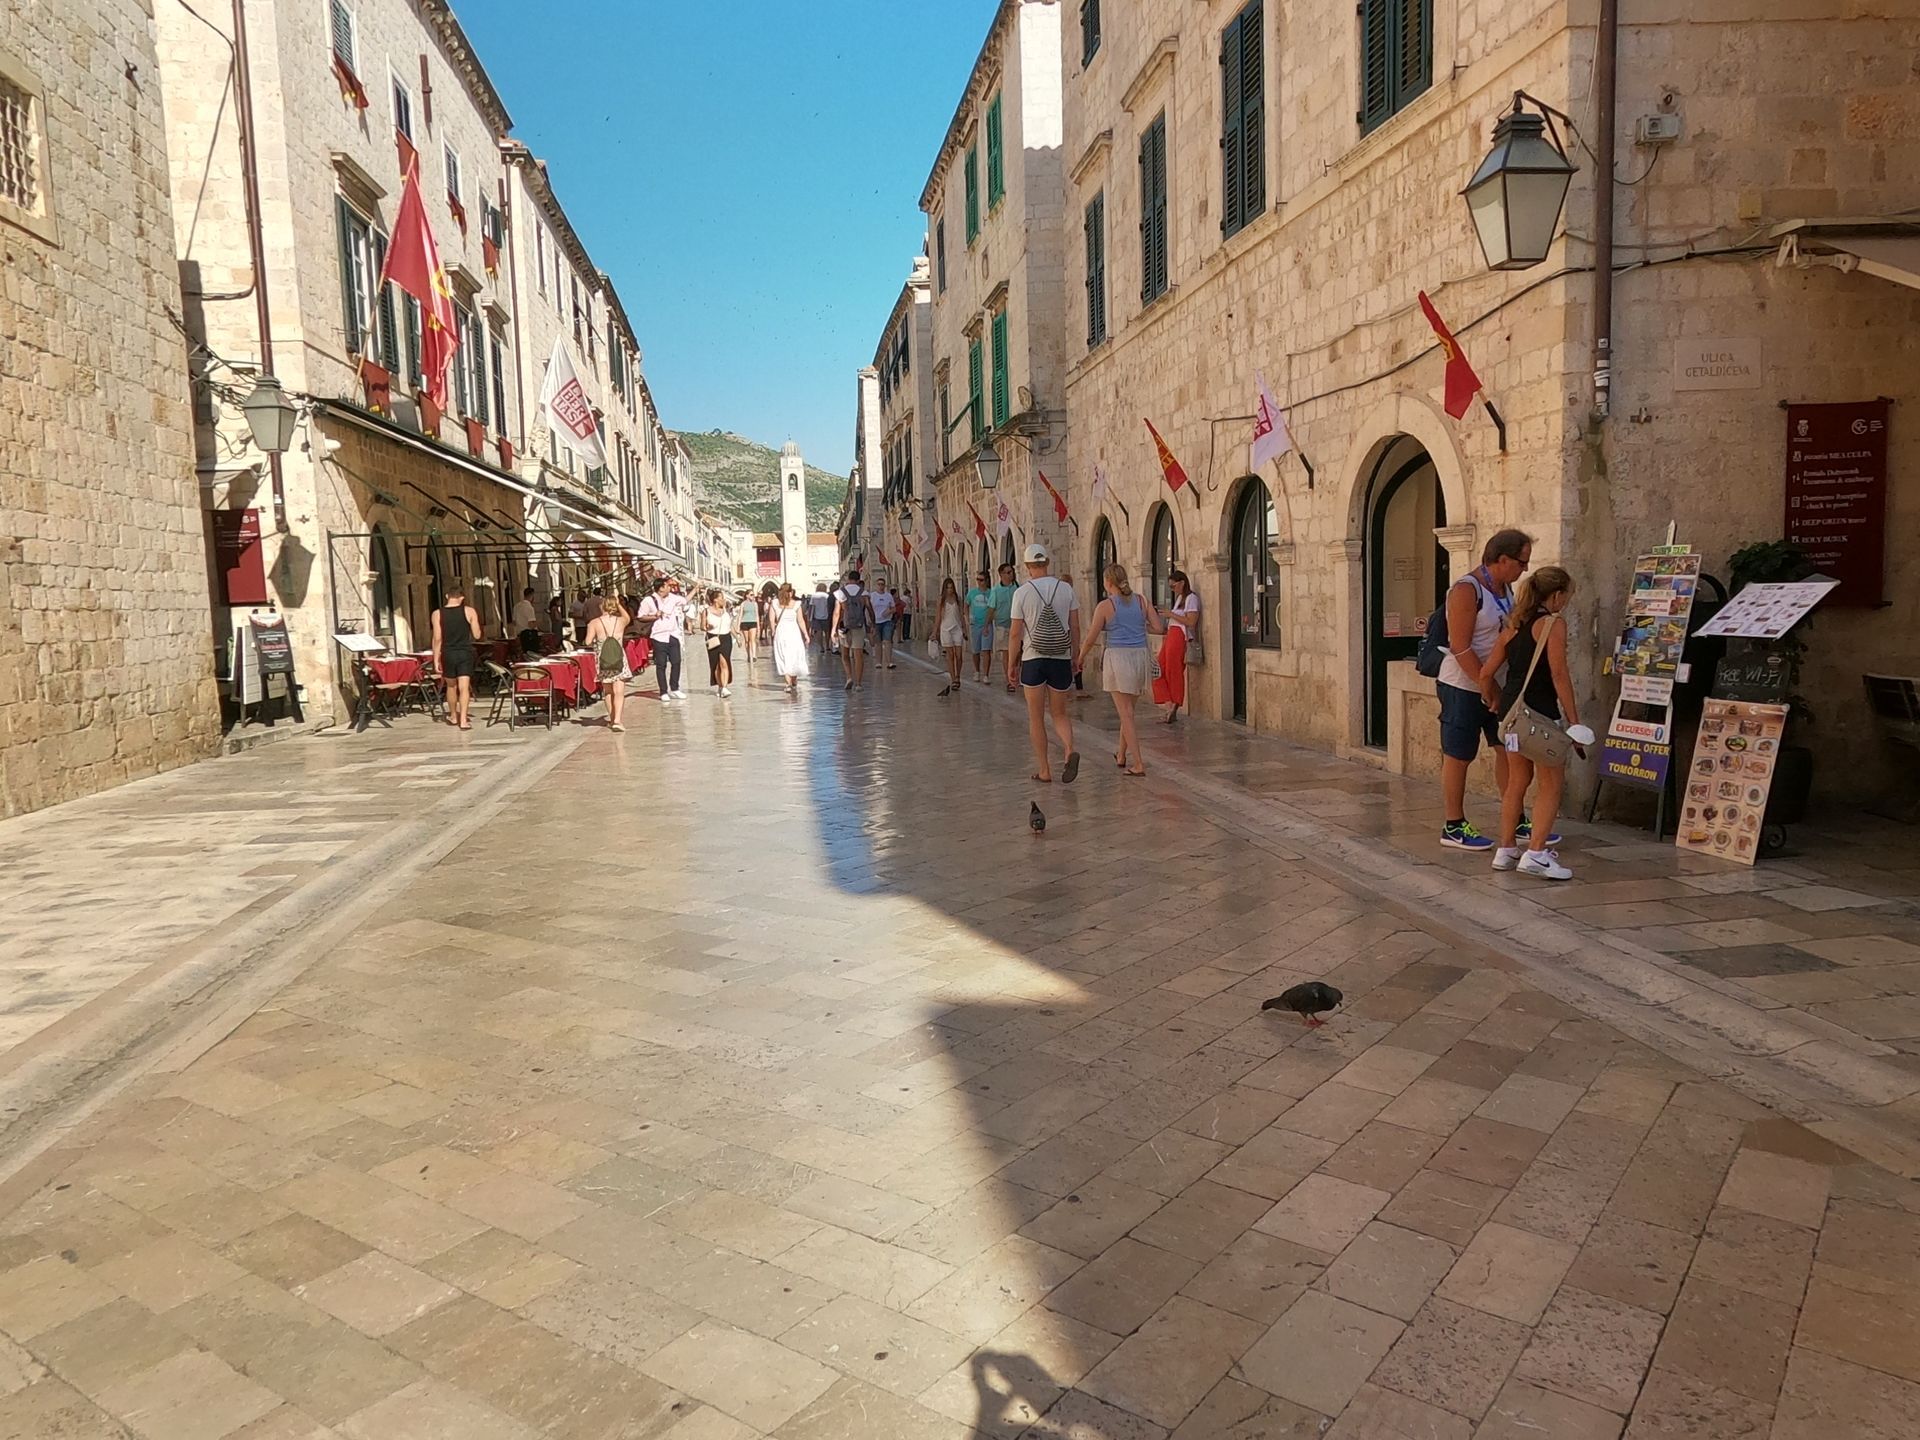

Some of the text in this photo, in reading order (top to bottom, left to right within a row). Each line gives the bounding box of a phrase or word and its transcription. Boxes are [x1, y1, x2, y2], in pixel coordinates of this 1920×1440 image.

[1701, 352, 1735, 363] ULICA
[556, 397, 579, 423] TAS
[1605, 739, 1670, 756] SPECIAL OFFER
[1609, 762, 1658, 781] TOMORROW
